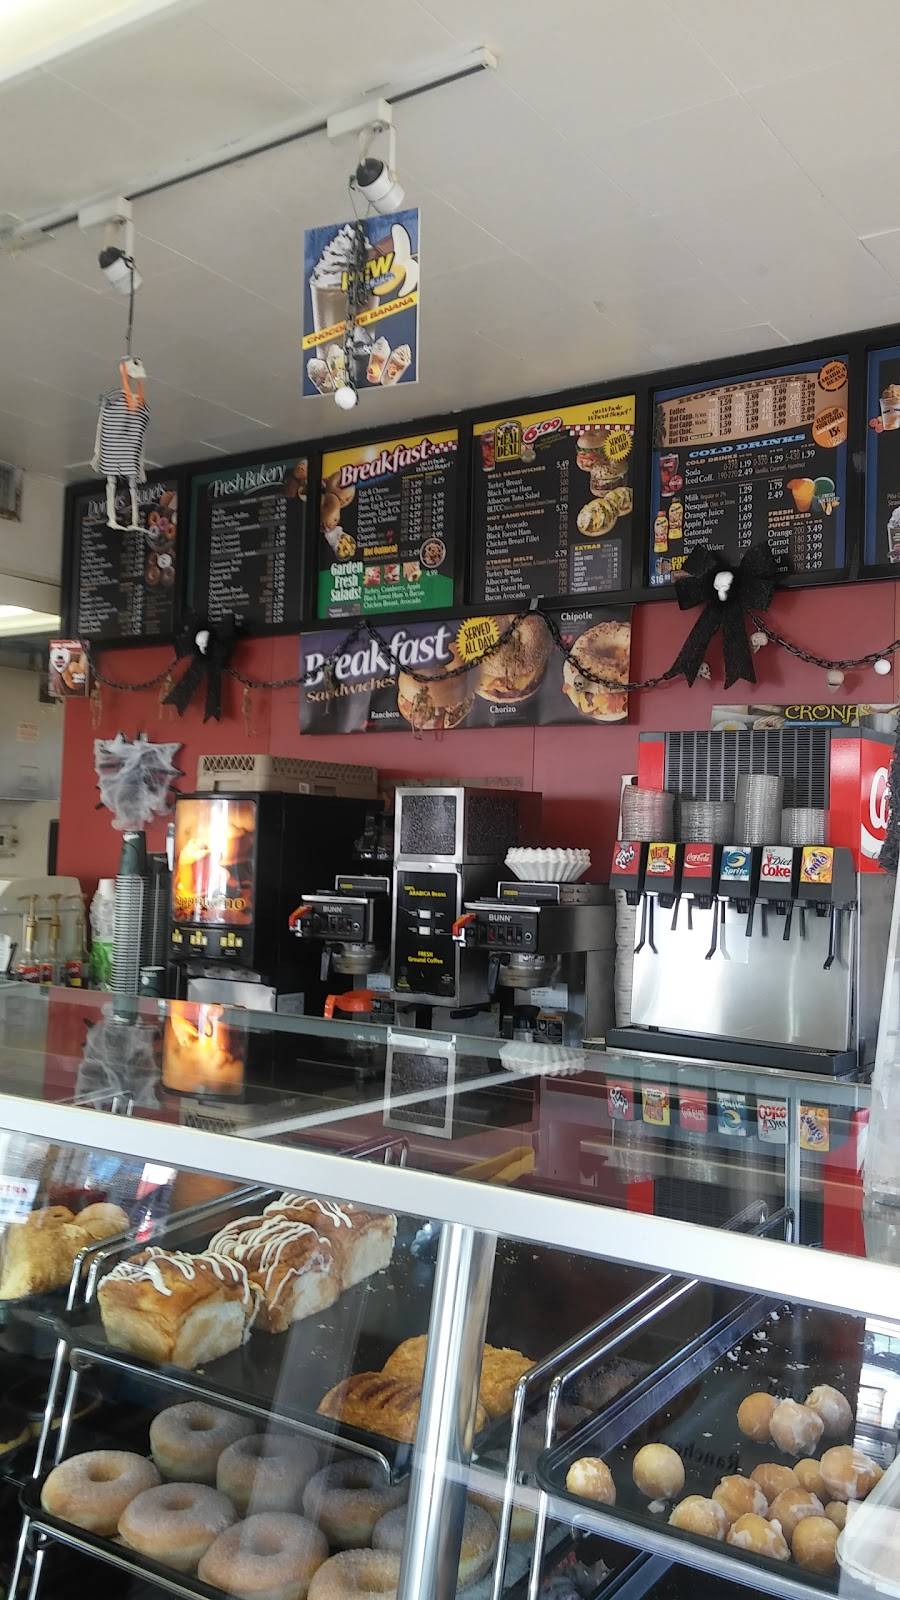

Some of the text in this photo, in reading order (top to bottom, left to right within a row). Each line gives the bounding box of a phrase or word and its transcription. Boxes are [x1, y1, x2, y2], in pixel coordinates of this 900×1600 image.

[370, 297, 414, 319] BANANA
[678, 389, 721, 404] HOT
[669, 408, 686, 416] Coffee
[496, 443, 520, 458] DEAL
[522, 417, 561, 444] 6.99
[608, 432, 628, 446] SERVED
[609, 440, 630, 455] ALL DAY!
[688, 434, 806, 458] COLD DRINKS
[340, 438, 432, 489] Breakfast
[556, 459, 570, 469] 5.49
[685, 468, 700, 477] Soda
[739, 460, 752, 469] 1.19
[770, 454, 783, 464] 1.29
[802, 450, 815, 460] 1.39
[686, 457, 707, 466] COLD
[708, 454, 738, 463] DRINKS
[208, 464, 288, 498] Fresh Bakery
[685, 476, 698, 485] Iced
[699, 474, 714, 484] Coff.
[738, 468, 753, 477] 2.49
[487, 478, 523, 491] Turkey Breast
[487, 485, 532, 498] Black Forest Ham
[685, 493, 699, 502] Milk
[739, 486, 752, 494] 1.29
[769, 481, 783, 490] 1.79
[487, 496, 510, 506] Albacore
[511, 495, 524, 503] Tuna
[524, 491, 540, 501] Salad
[684, 501, 709, 512] Nesquik
[739, 495, 752, 504] 1.49
[767, 490, 784, 500] 2.49
[501, 509, 545, 519] SANDWICHES
[555, 503, 569, 512] 5.79
[684, 510, 707, 521] Orange
[708, 508, 724, 518] Juice
[739, 504, 752, 513] 1.49
[768, 508, 793, 517] FRESH
[768, 512, 811, 523] SQUEEZED
[487, 520, 529, 533] Turkey Avocado
[683, 513, 752, 530] Apple Juice 1.69
[768, 521, 790, 529] JUICE
[486, 528, 532, 540] Black Forest Ham
[683, 522, 752, 538] Gatorade 1.69
[767, 524, 823, 539] Orange 3.49
[486, 535, 540, 549] Chicken Breast Fillet
[683, 531, 752, 547] Snapple 1.69
[707, 542, 725, 552] Water
[738, 539, 751, 548] 1.29
[767, 533, 823, 547] Carrot 3.99
[486, 547, 509, 556] Pastrami
[555, 550, 568, 558] 5.79
[806, 543, 823, 552] 3.99
[805, 552, 823, 561] 4.49
[330, 561, 364, 577] Garden
[486, 567, 521, 578] Turkey Breast
[805, 561, 823, 571] 4.49
[335, 573, 359, 591] Fresh
[486, 575, 523, 586] Albacore Tuna
[330, 586, 362, 602] Salads!
[485, 582, 531, 593] Black Forest Ham
[485, 591, 526, 601] Bacon Avocado
[560, 611, 593, 624] Chipotle
[463, 621, 491, 642] SERVED
[465, 634, 496, 655] ALL DAY!
[370, 710, 400, 720] Ranchero
[489, 704, 517, 715] Chorizo
[772, 856, 793, 867] Diet
[803, 855, 829, 878] Fanta
[723, 866, 749, 877] Sprite
[761, 864, 792, 878] Coke
[431, 890, 447, 898] Beans
[322, 905, 342, 913] BUNN
[488, 914, 511, 923] BUNN
[427, 957, 444, 965] Coffee
